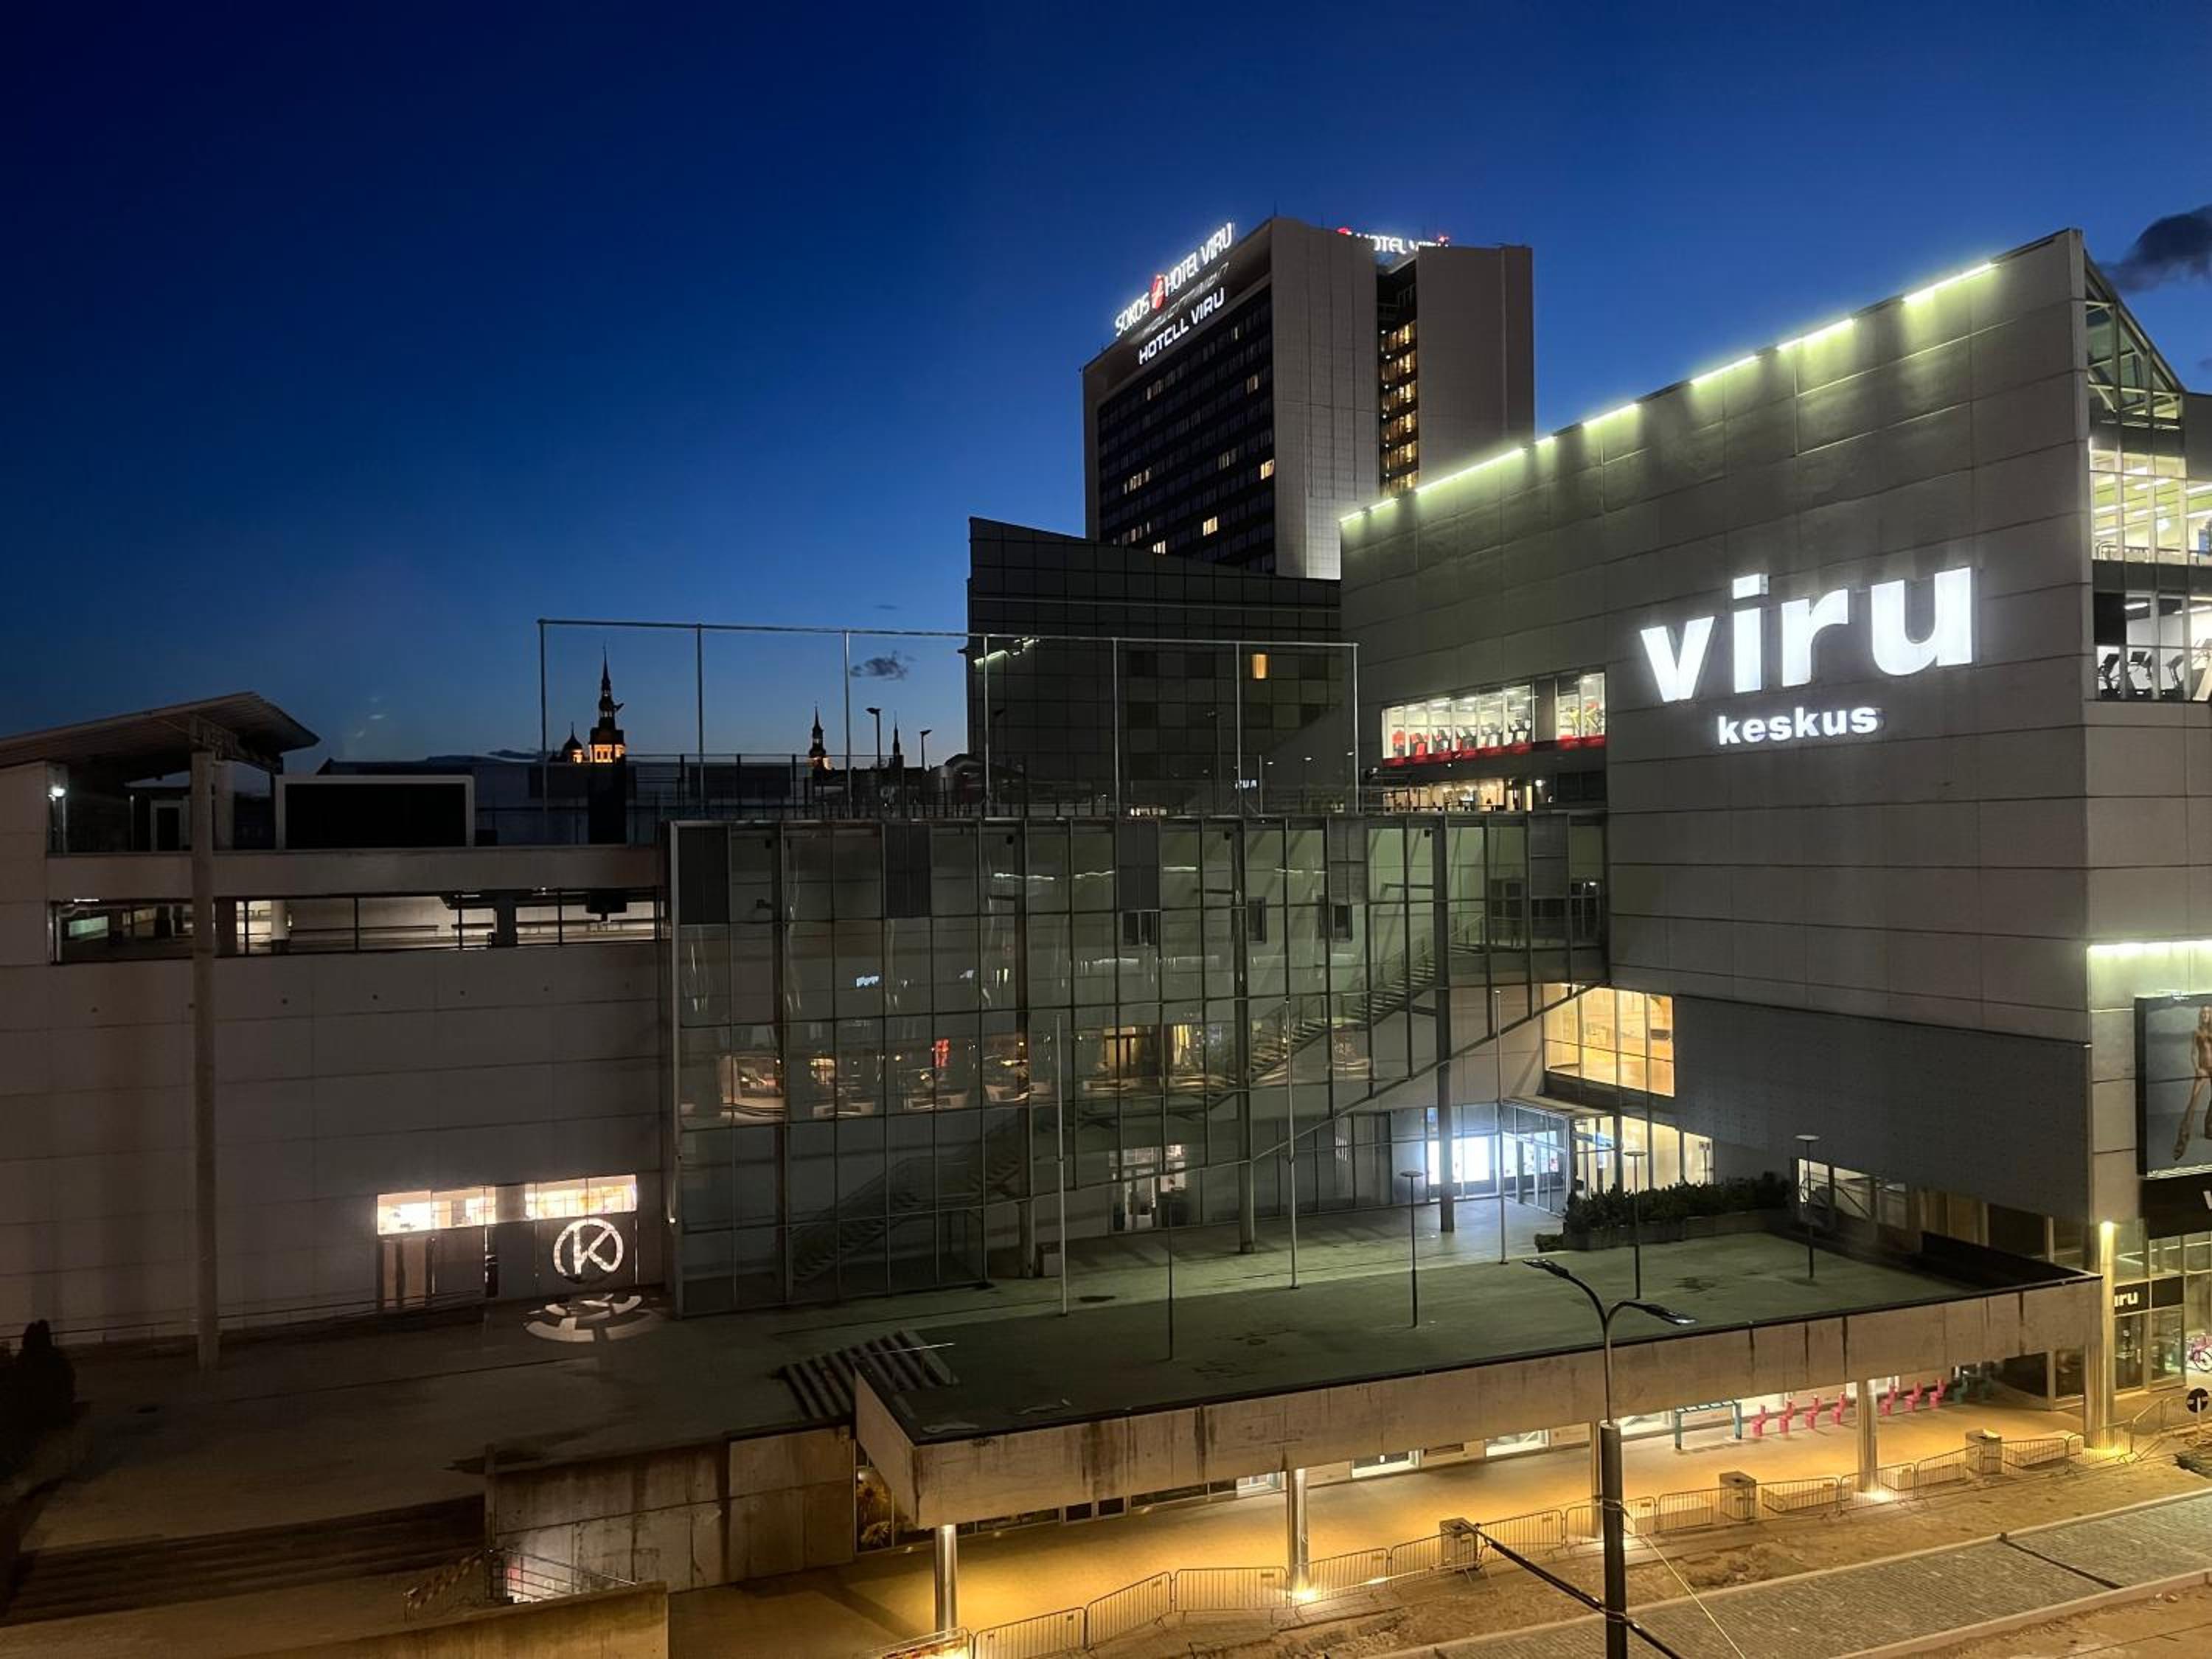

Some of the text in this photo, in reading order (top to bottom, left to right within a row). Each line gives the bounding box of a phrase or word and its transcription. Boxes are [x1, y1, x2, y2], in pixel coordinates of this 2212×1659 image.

[1115, 222, 1232, 337] SOKOS HOTEL VIRU
[1191, 287, 1225, 325] VIRU
[1641, 567, 1972, 703] viru
[1718, 706, 1879, 745] keskus
